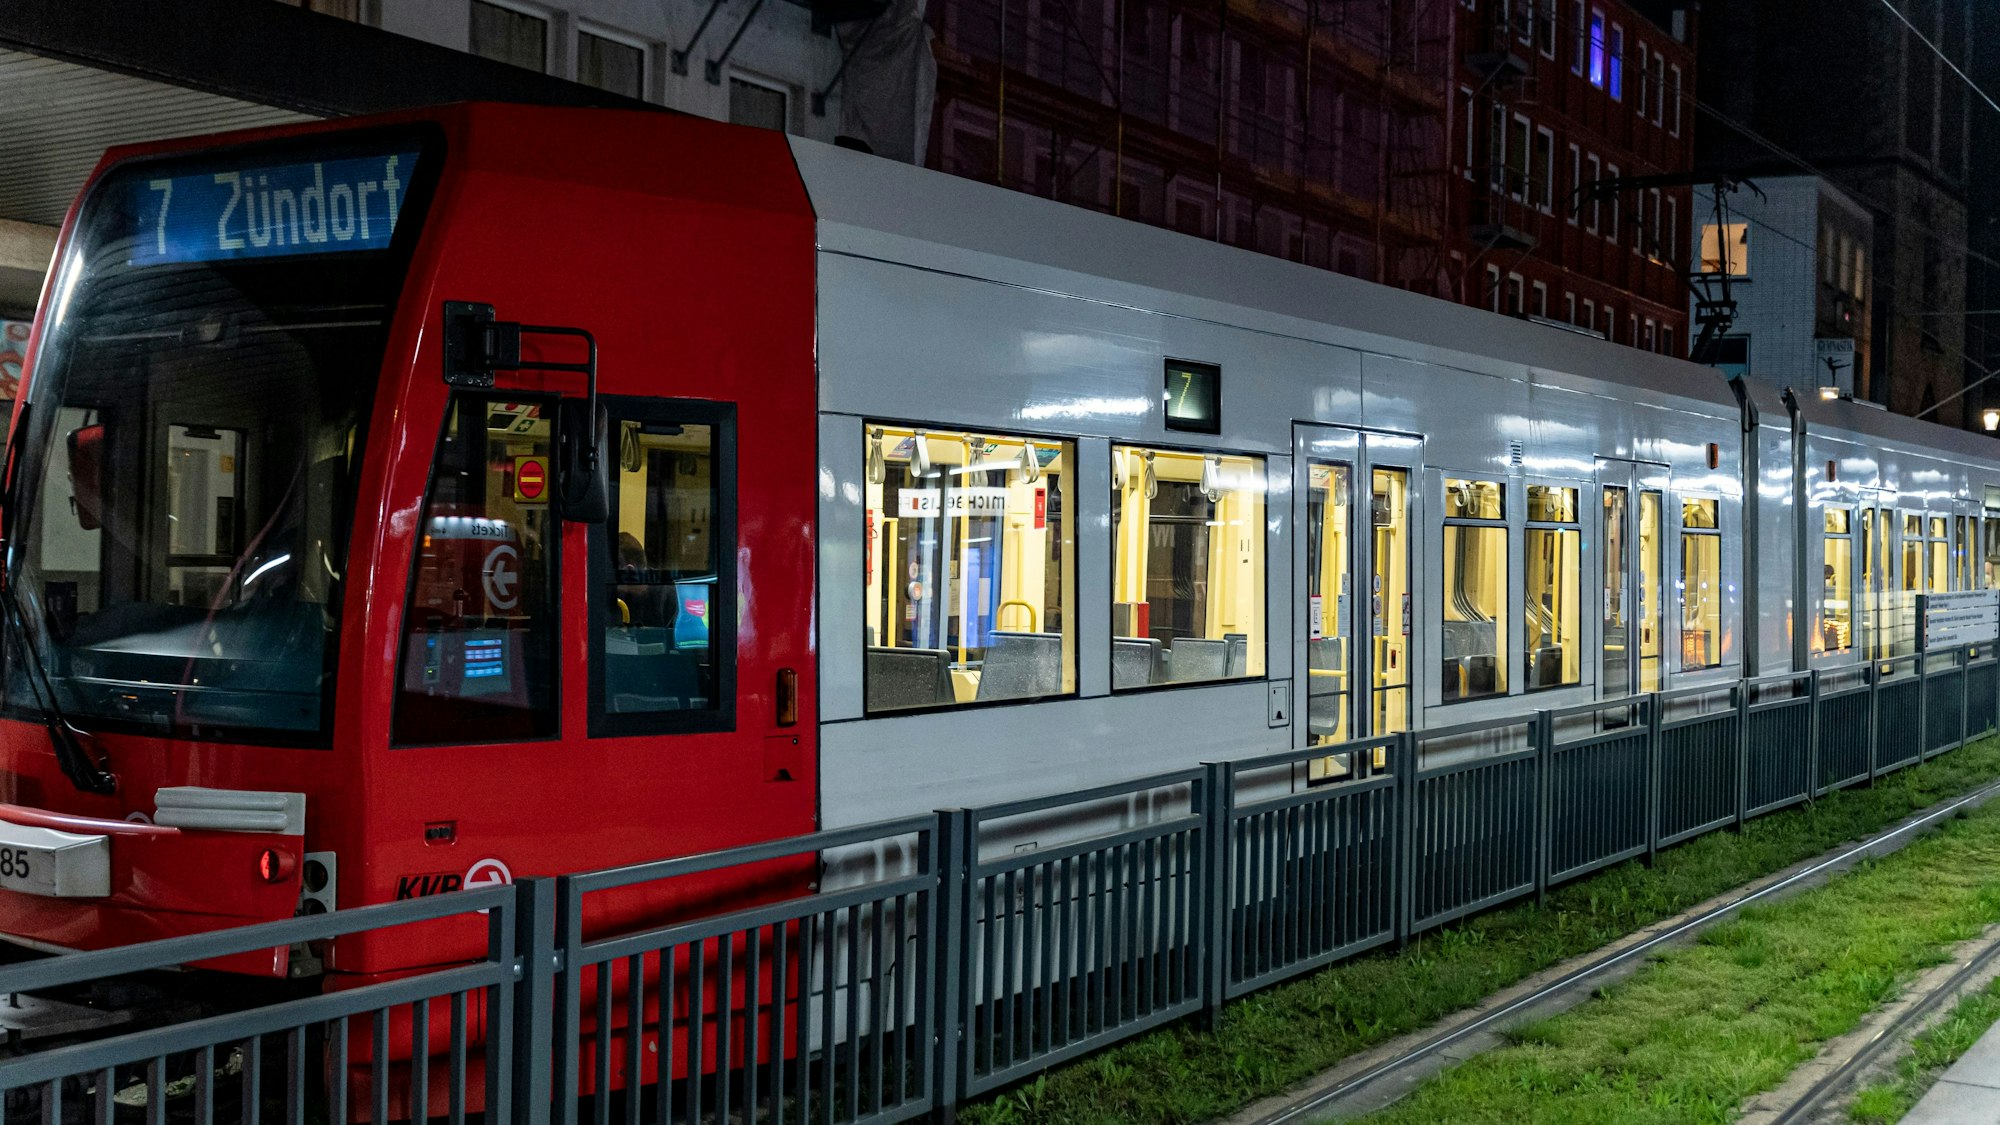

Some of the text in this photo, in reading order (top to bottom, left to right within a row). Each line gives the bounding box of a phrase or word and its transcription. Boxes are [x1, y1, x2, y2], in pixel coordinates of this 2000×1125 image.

[149, 154, 401, 255] 7 Zündorf
[1177, 372, 1193, 418] 7
[0, 847, 30, 879] 85
